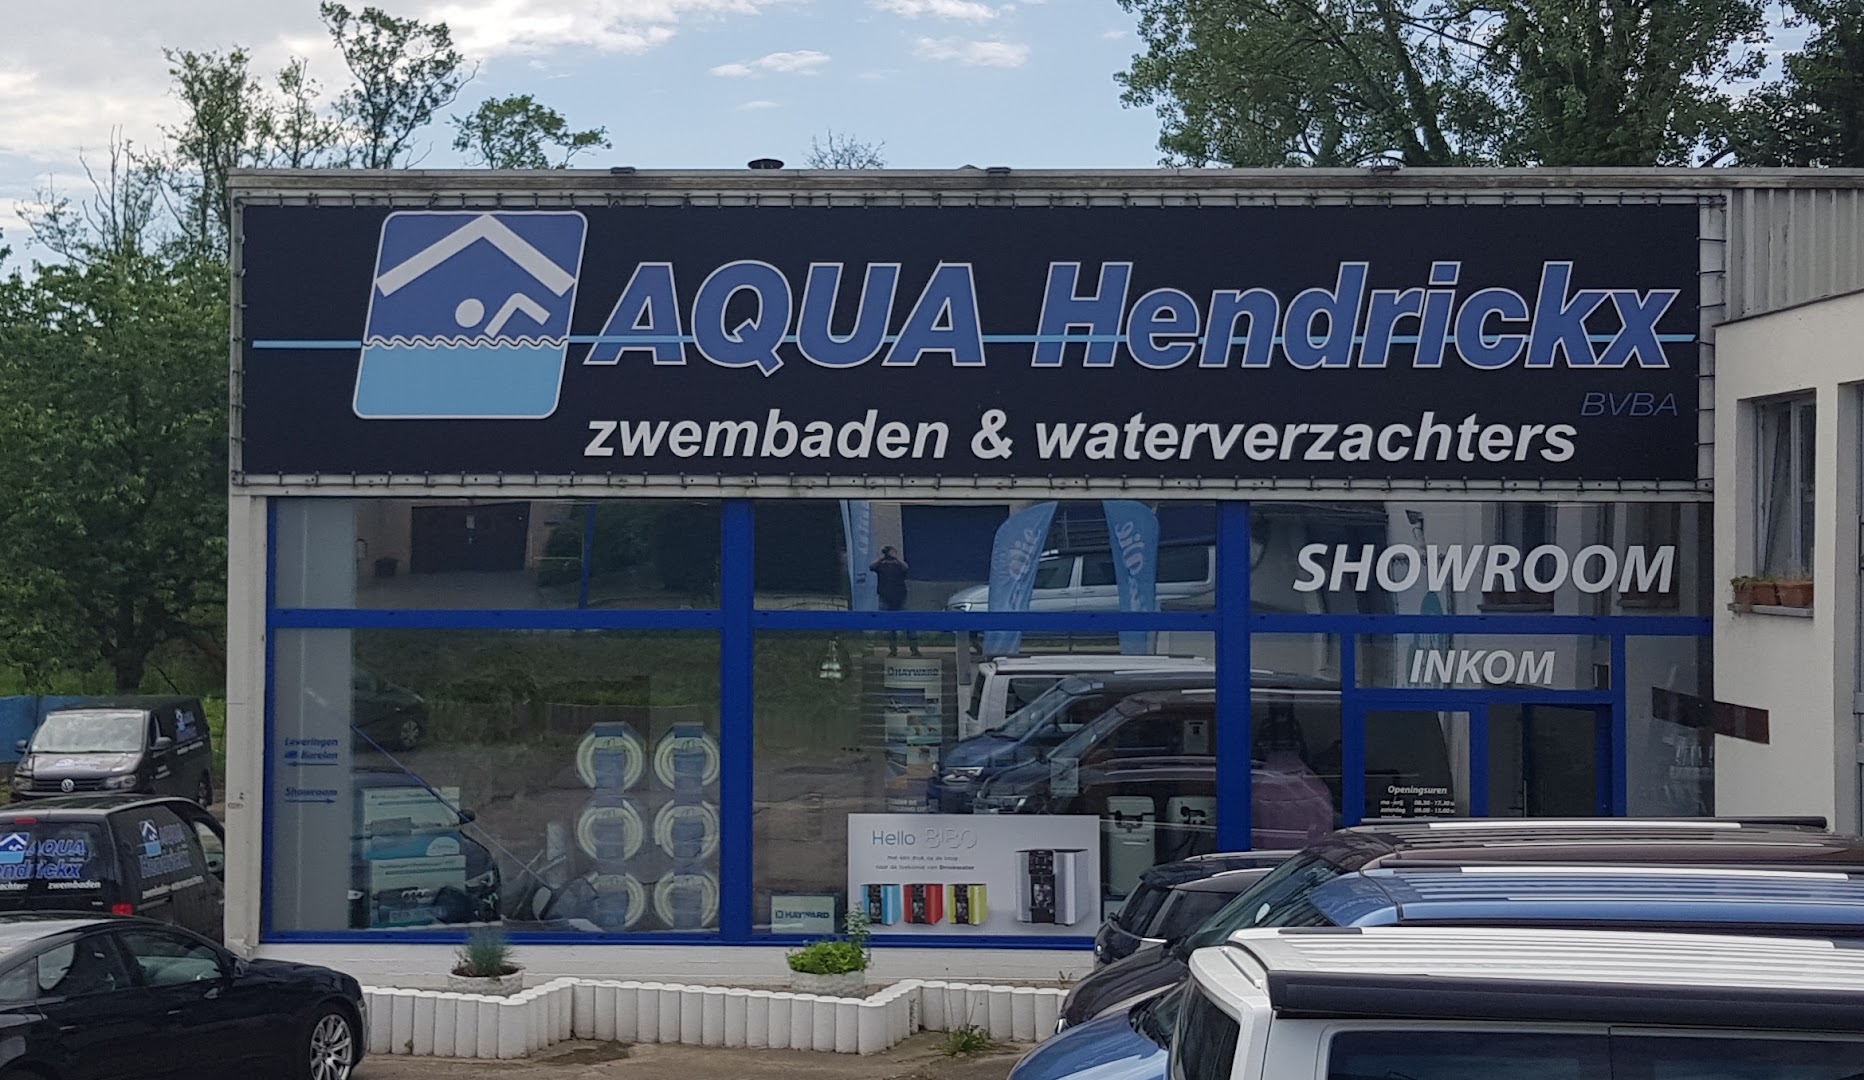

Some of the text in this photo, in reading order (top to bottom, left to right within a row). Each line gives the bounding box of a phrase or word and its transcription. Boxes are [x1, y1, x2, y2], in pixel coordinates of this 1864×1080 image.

[583, 260, 1681, 377] AQUA Hendrickx
[1580, 392, 1680, 417] BVBA
[584, 409, 1578, 462] zwembaden & waterverzachters
[1293, 544, 1675, 593] SHOWROOM
[1409, 649, 1556, 685] INKOM
[285, 787, 338, 796] Showroom
[1388, 785, 1447, 796] Openingsuren
[25, 839, 86, 858] AQUA
[872, 828, 978, 849] Hello BIBO
[47, 880, 101, 890] zwembaden
